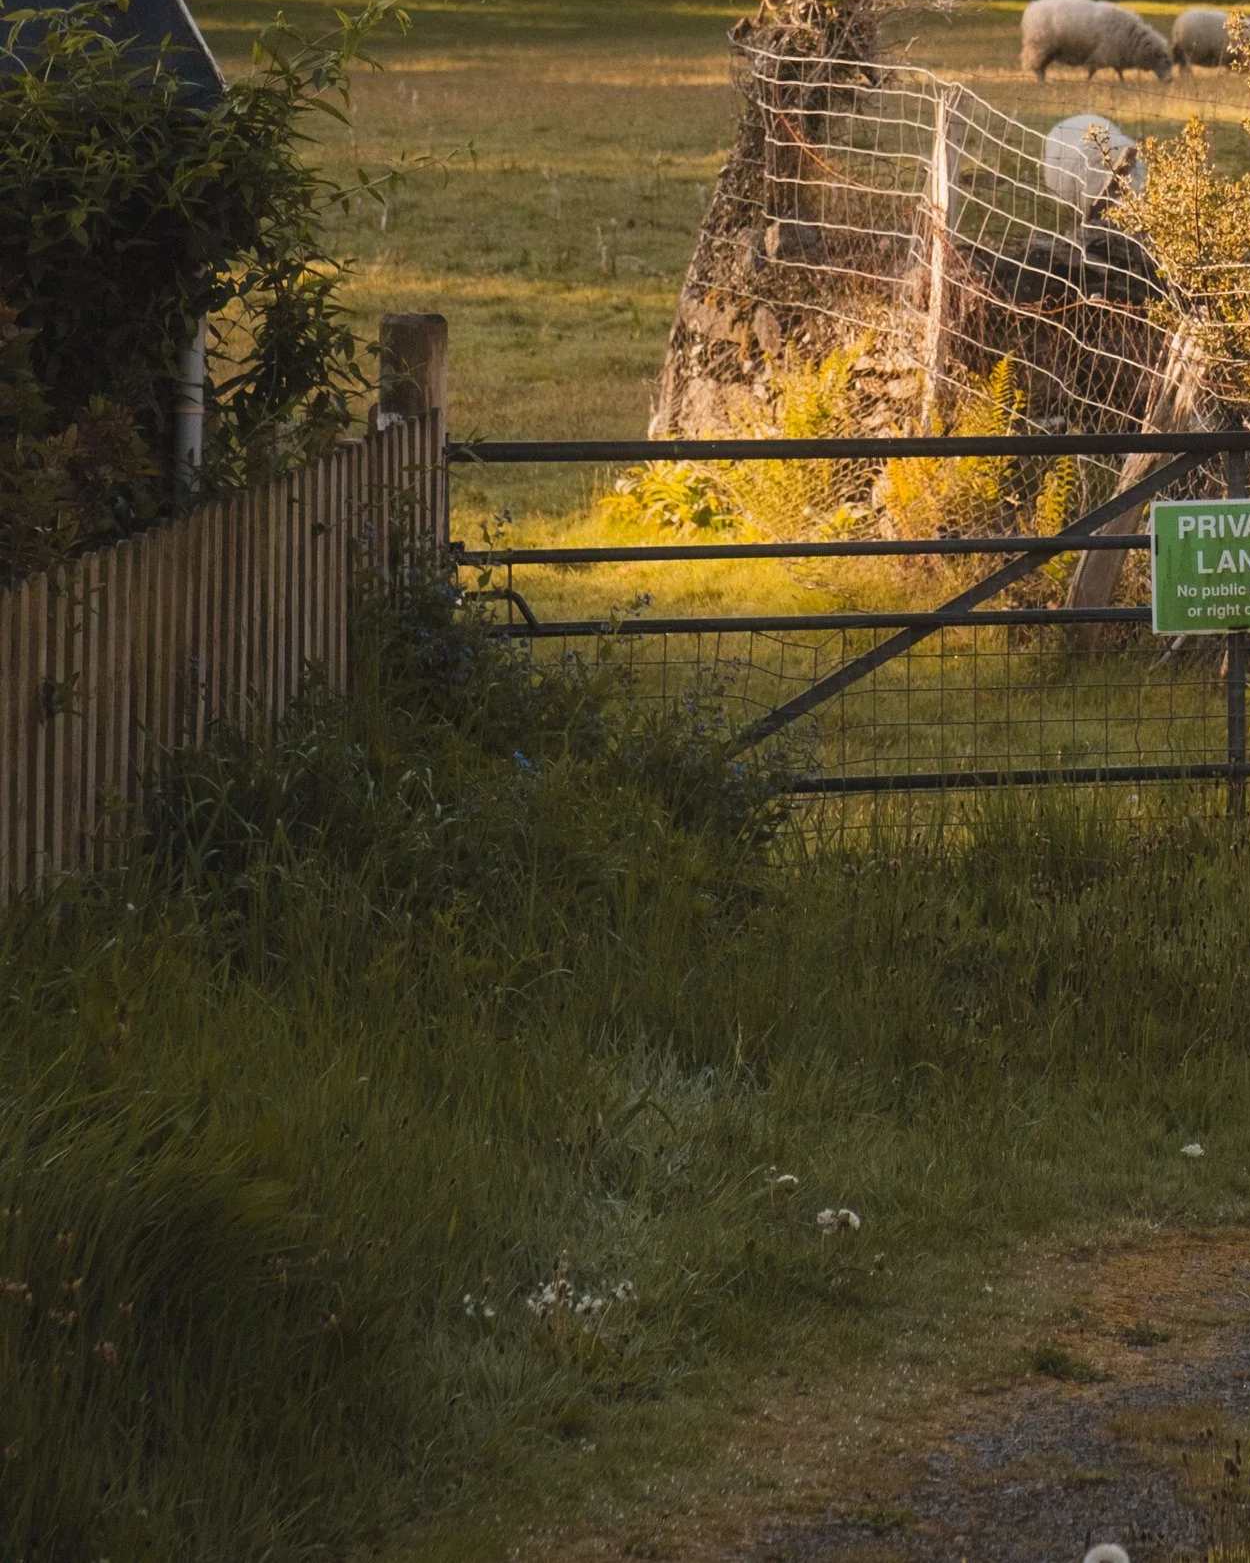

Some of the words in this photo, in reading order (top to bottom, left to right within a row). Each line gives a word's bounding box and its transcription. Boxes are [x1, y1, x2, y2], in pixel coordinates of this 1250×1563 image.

[1177, 584, 1197, 598] No
[1202, 583, 1246, 599] public
[1187, 606, 1202, 617] or
[1206, 604, 1240, 619] right
